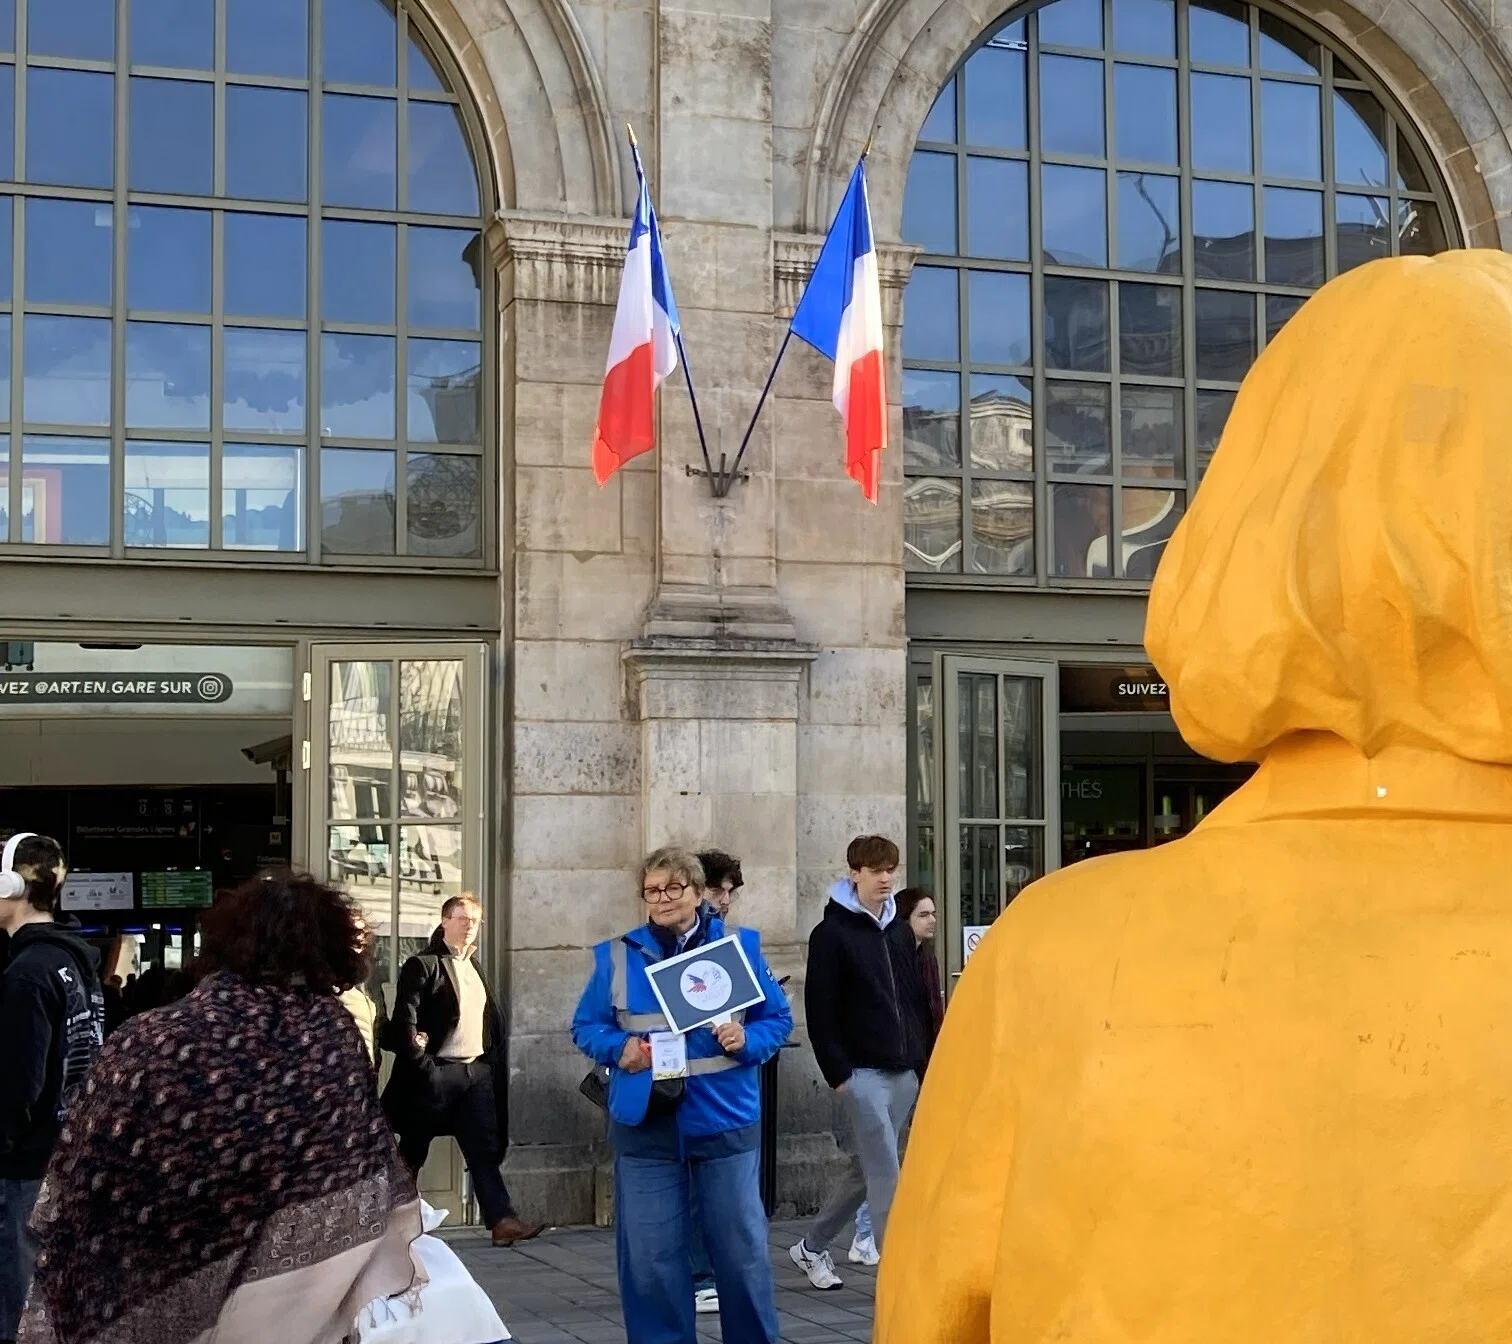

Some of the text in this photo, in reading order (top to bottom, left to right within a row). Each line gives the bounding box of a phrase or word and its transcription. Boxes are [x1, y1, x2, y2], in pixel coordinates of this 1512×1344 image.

[35, 680, 157, 694] @ART.EN.GARE
[160, 681, 192, 694] SUR
[1118, 683, 1167, 695] SUIVEZ
